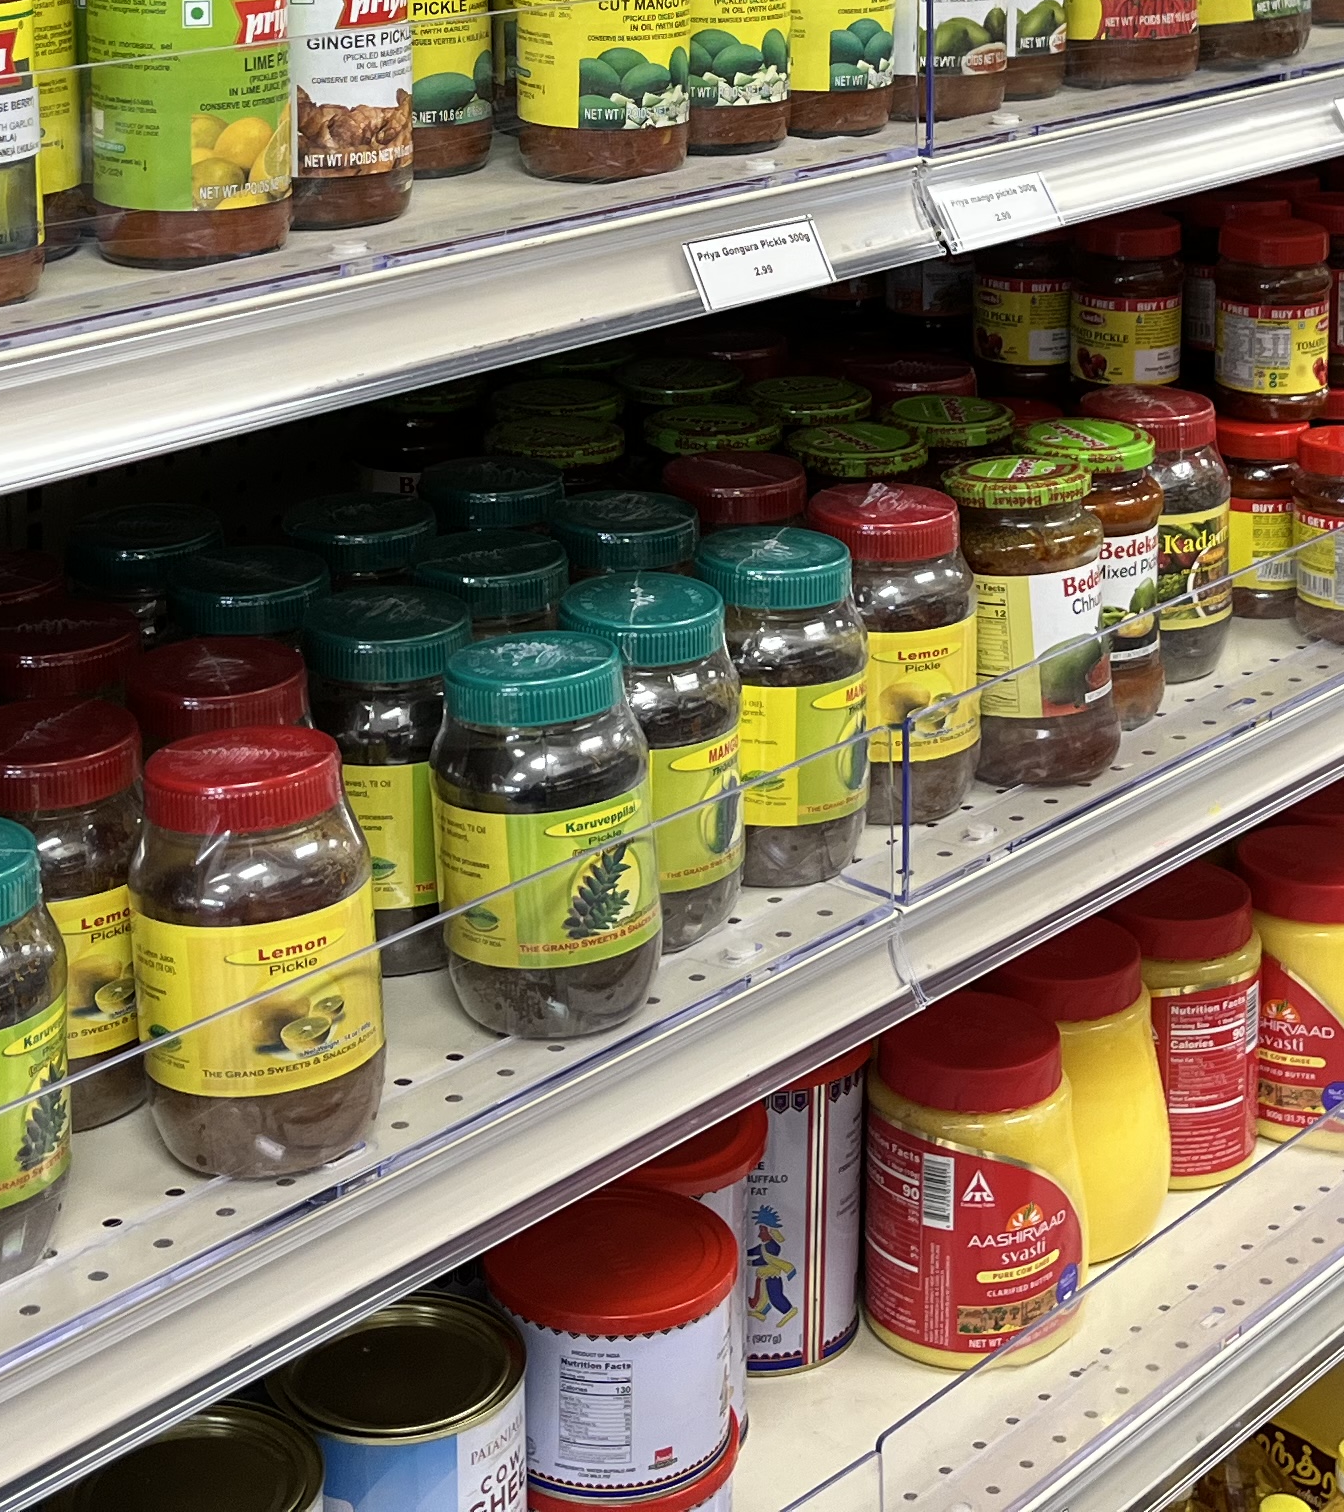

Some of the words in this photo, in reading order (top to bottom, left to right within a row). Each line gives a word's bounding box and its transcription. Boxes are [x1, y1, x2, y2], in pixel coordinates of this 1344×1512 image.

[413, 0, 467, 16] PICKLE
[307, 34, 377, 53] GINGER
[304, 152, 326, 168] NET
[327, 151, 342, 167] WT
[697, 250, 720, 262] Priya
[722, 242, 759, 257] Gongura
[760, 237, 787, 250] Pickle
[788, 232, 811, 243] 300g
[754, 264, 773, 276] 2.99
[897, 645, 949, 663] Lemon
[905, 661, 941, 675] Pickle
[257, 933, 328, 963] Lemon
[519, 942, 541, 955] THE
[542, 939, 580, 955] GRAND
[581, 931, 618, 951] SWEETS
[268, 955, 318, 977] Pickle
[1170, 1004, 1216, 1016] Nutrition
[1219, 995, 1247, 1009] Facts
[1170, 1038, 1214, 1051] Calories
[1232, 1026, 1246, 1040] 90
[202, 1068, 223, 1080] THE
[225, 1066, 265, 1080] GRAND
[266, 1059, 312, 1076] SWEETS
[313, 1056, 323, 1066] &
[322, 1040, 358, 1065] SNACKS
[967, 1209, 1067, 1249] AASHIRVAAD
[1001, 1238, 1046, 1265] svasti
[987, 1284, 1028, 1298] CLARIFIED
[561, 1357, 602, 1371] Nutrition
[604, 1360, 632, 1371] Facts
[615, 1385, 631, 1394] 130
[481, 1447, 521, 1494] COW
